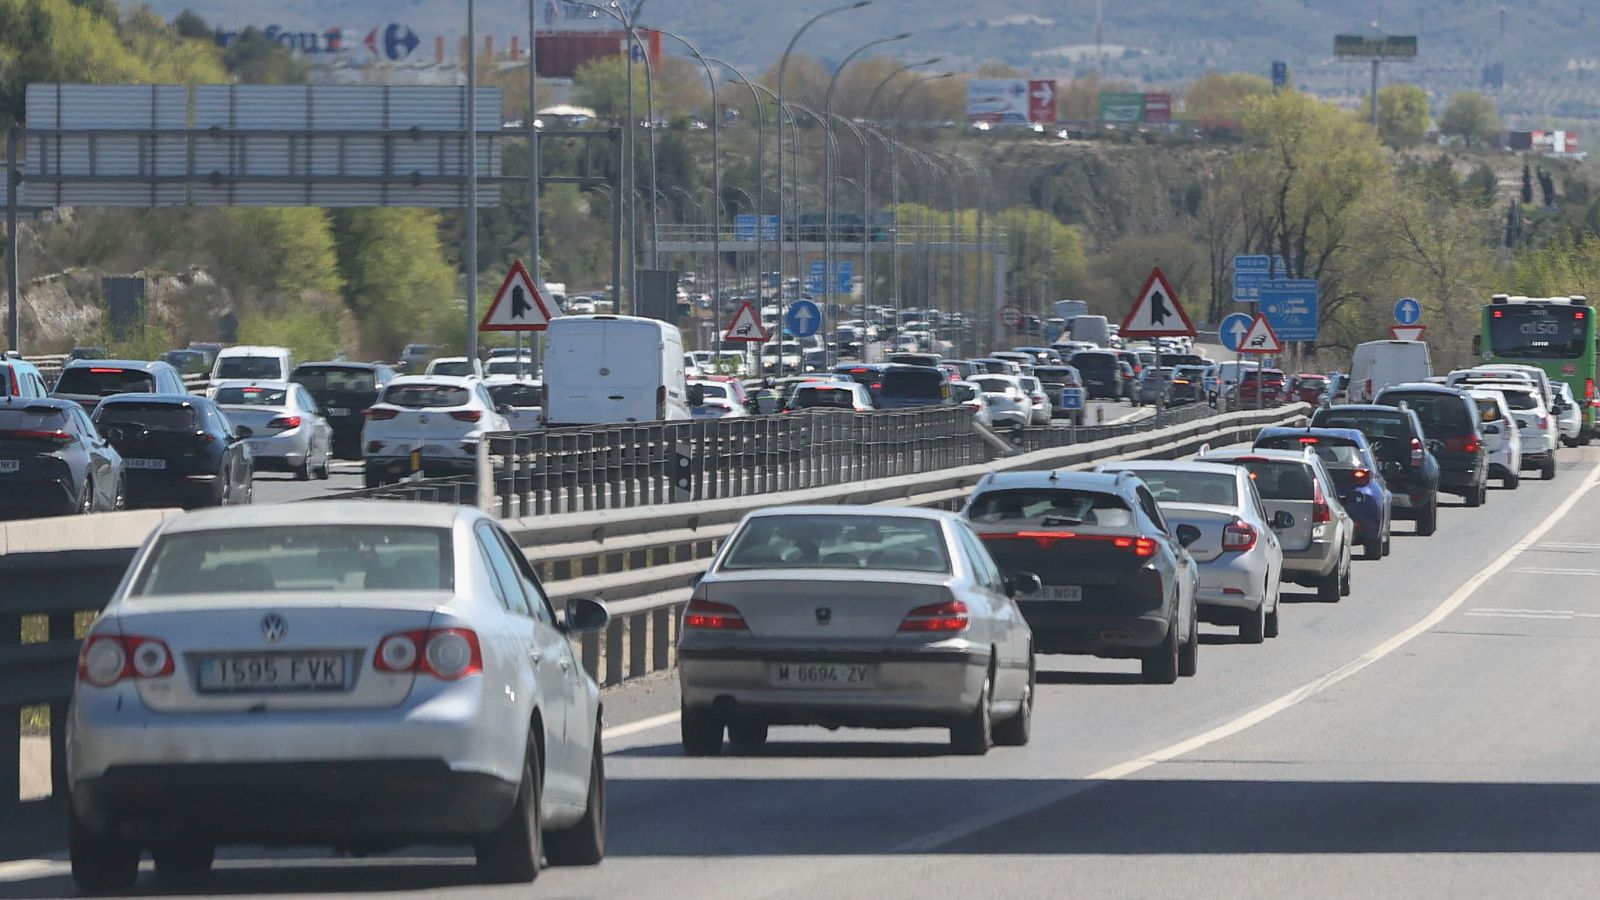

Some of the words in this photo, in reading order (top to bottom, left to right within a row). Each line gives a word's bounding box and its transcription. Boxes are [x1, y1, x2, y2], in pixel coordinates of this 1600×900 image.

[1519, 321, 1558, 335] alsa
[219, 659, 277, 684] 1595
[290, 659, 336, 685] FVK
[798, 666, 838, 682] 6694
[847, 666, 867, 682] ZV
